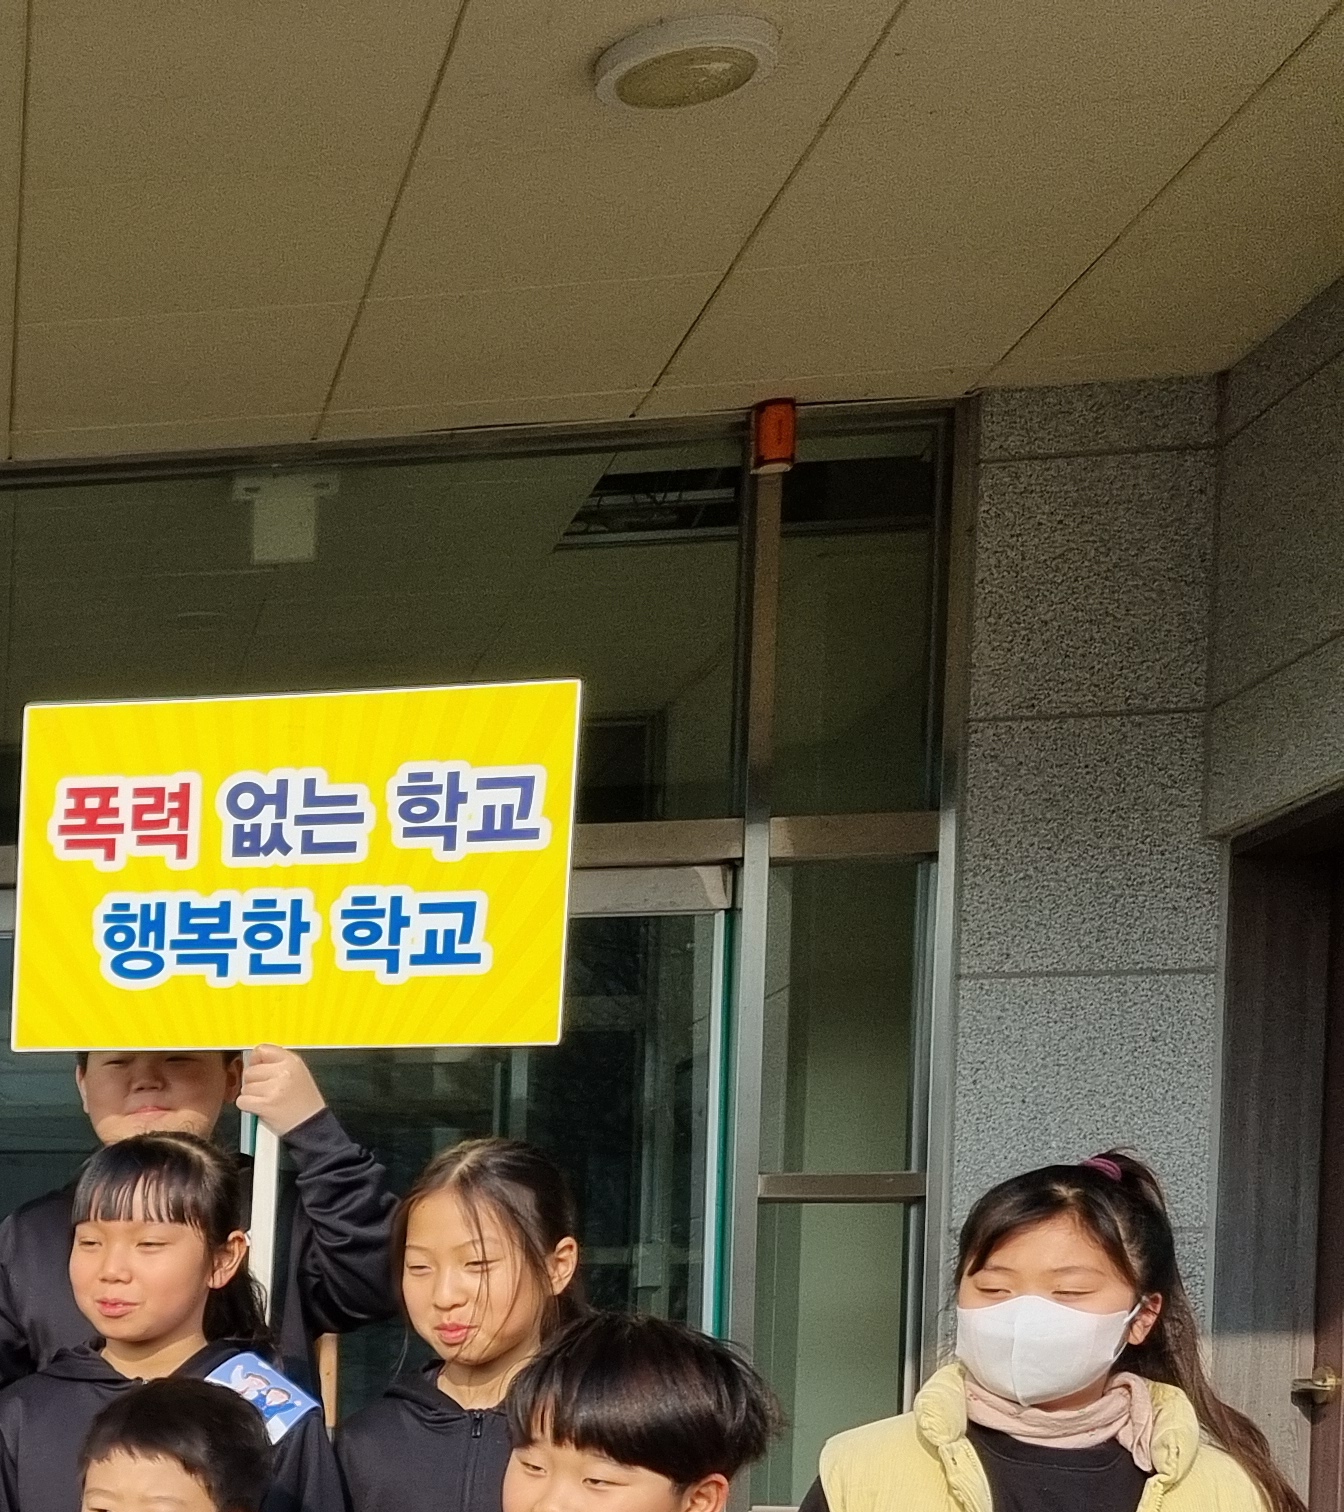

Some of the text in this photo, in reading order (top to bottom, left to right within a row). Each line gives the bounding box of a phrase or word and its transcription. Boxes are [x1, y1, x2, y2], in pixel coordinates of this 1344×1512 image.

[58, 771, 541, 862] 폭력 없는 학교
[103, 895, 481, 980] 행복한 학교
